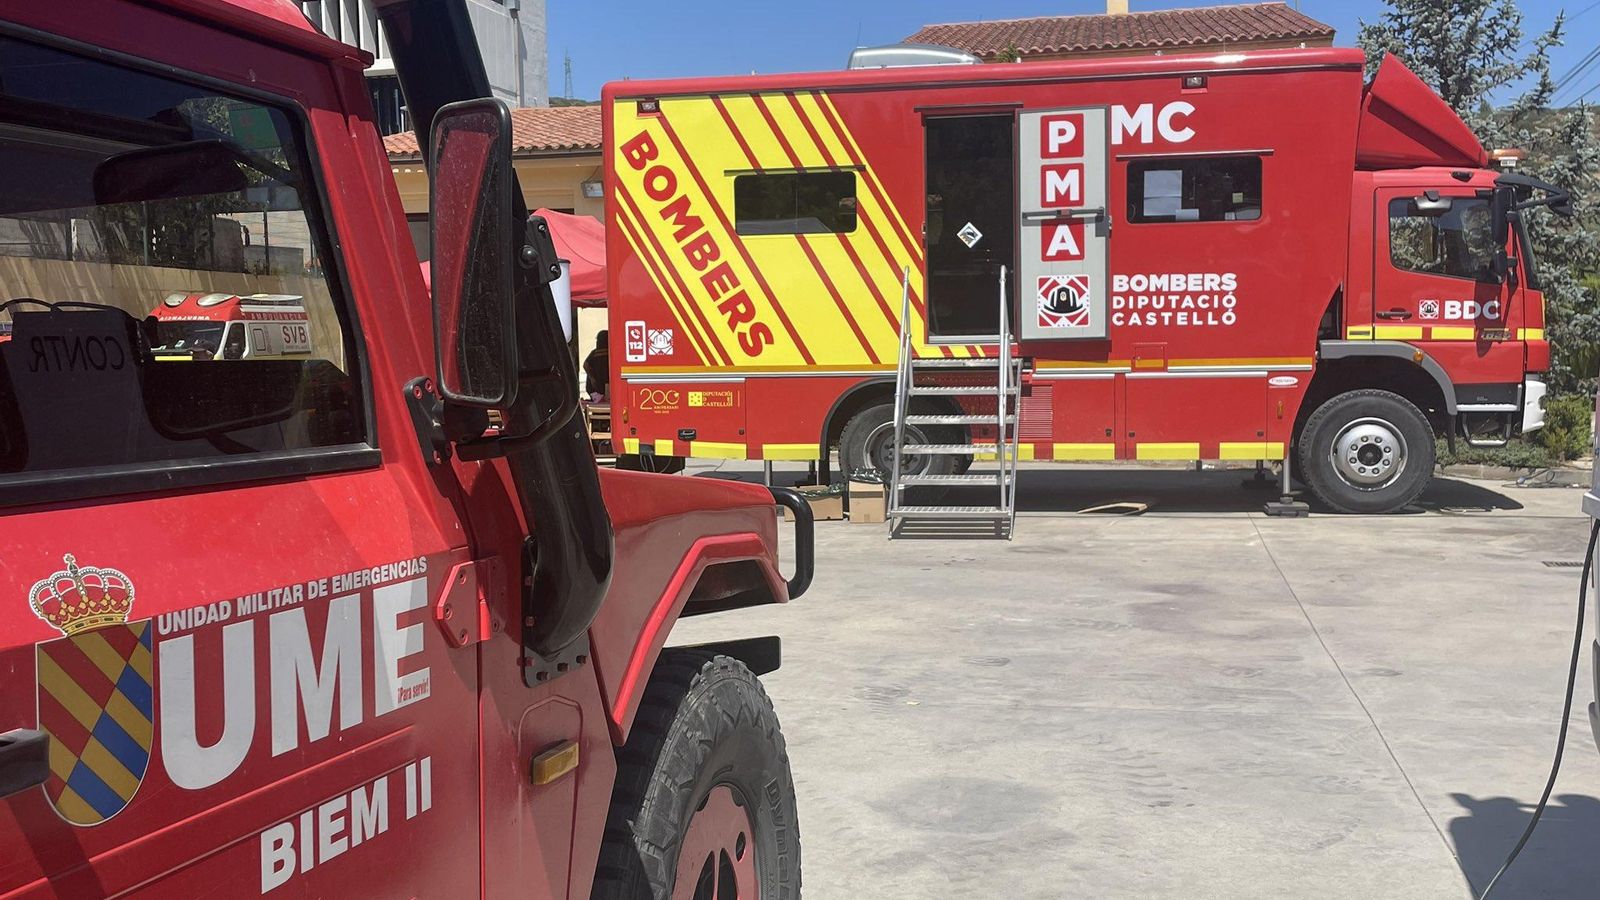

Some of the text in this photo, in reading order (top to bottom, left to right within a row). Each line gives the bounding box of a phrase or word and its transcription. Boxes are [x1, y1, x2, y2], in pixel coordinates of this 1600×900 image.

[1110, 100, 1196, 145] MC
[620, 129, 775, 358] BOMBERS
[1112, 272, 1237, 293] BOMBERS
[1112, 292, 1237, 310] DIPUTACIÓ
[1444, 300, 1500, 320] BDC
[1112, 308, 1237, 326] CASTELLÓ
[282, 325, 307, 344] SVB
[629, 341, 643, 350] 112
[158, 556, 427, 636] UNIDAD MILITAR DE EMERGENCIAS
[158, 577, 431, 790] UME
[260, 756, 432, 894] BIEM II
